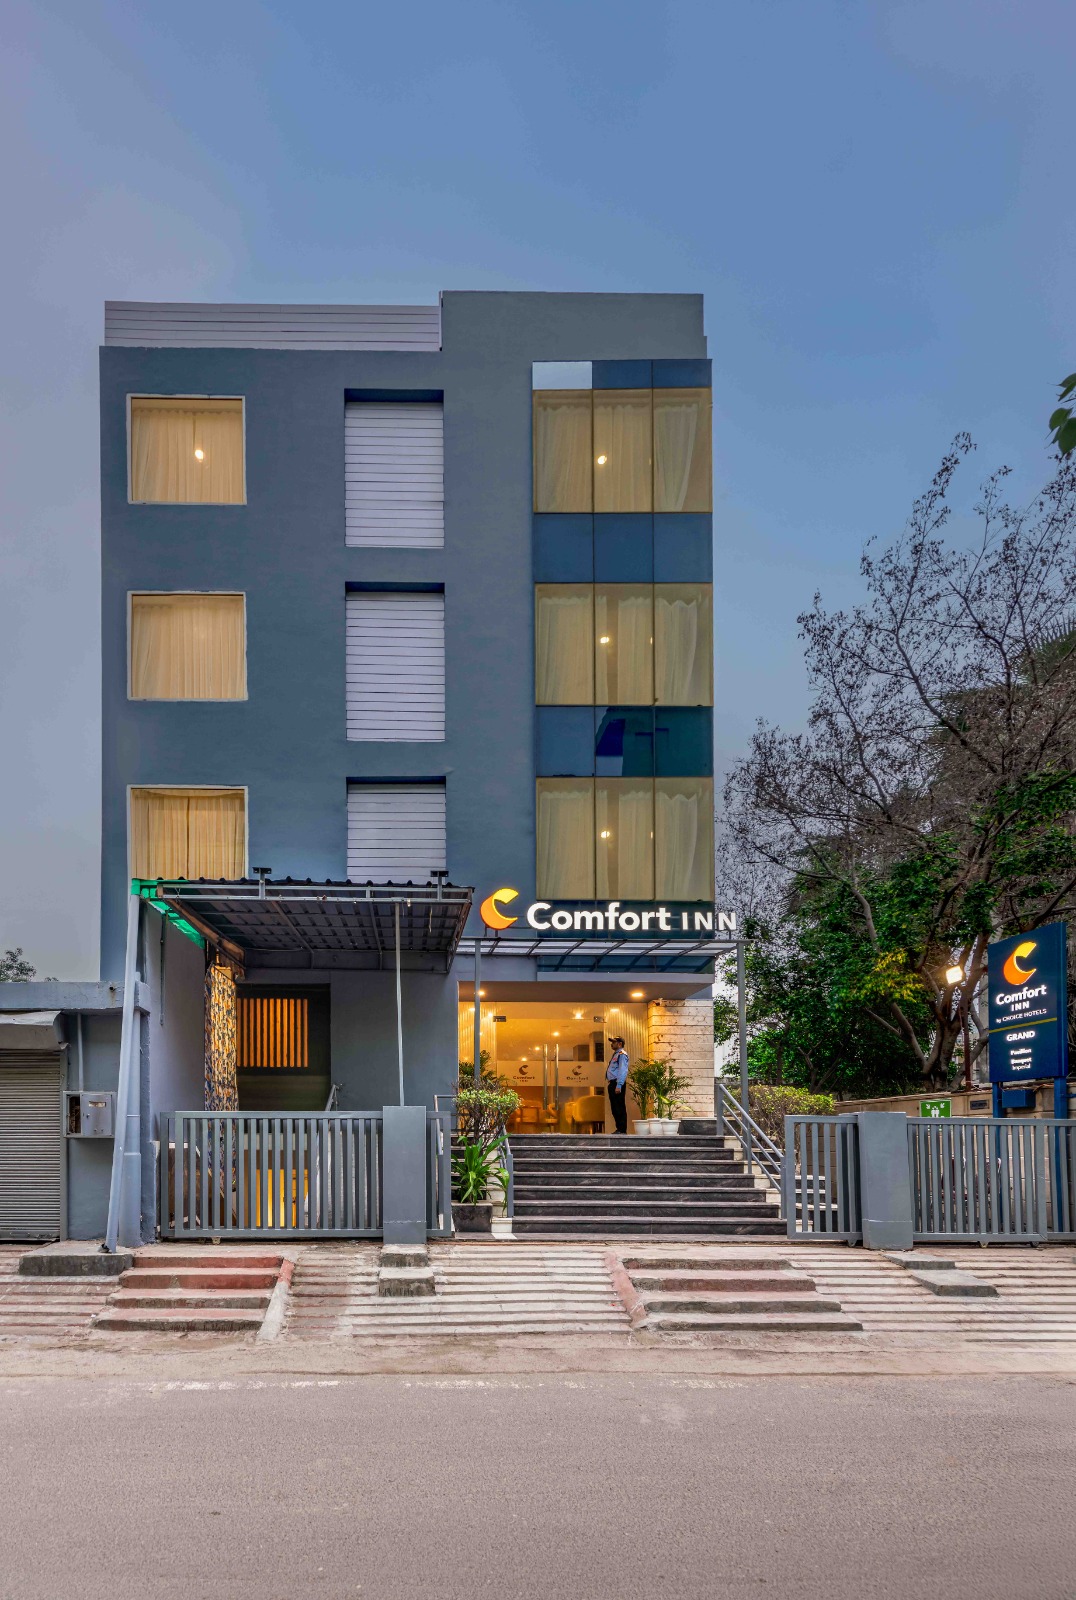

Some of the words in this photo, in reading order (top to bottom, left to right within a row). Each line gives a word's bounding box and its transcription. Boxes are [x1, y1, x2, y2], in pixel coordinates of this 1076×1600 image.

[526, 902, 671, 930] Comfort
[682, 911, 737, 930] INN
[996, 984, 1047, 1005] Comfort
[1011, 1001, 1030, 1011] INN
[1002, 1013, 1023, 1021] CHOICE
[1024, 1009, 1047, 1017] HOTELS
[1006, 1030, 1036, 1041] GRAND
